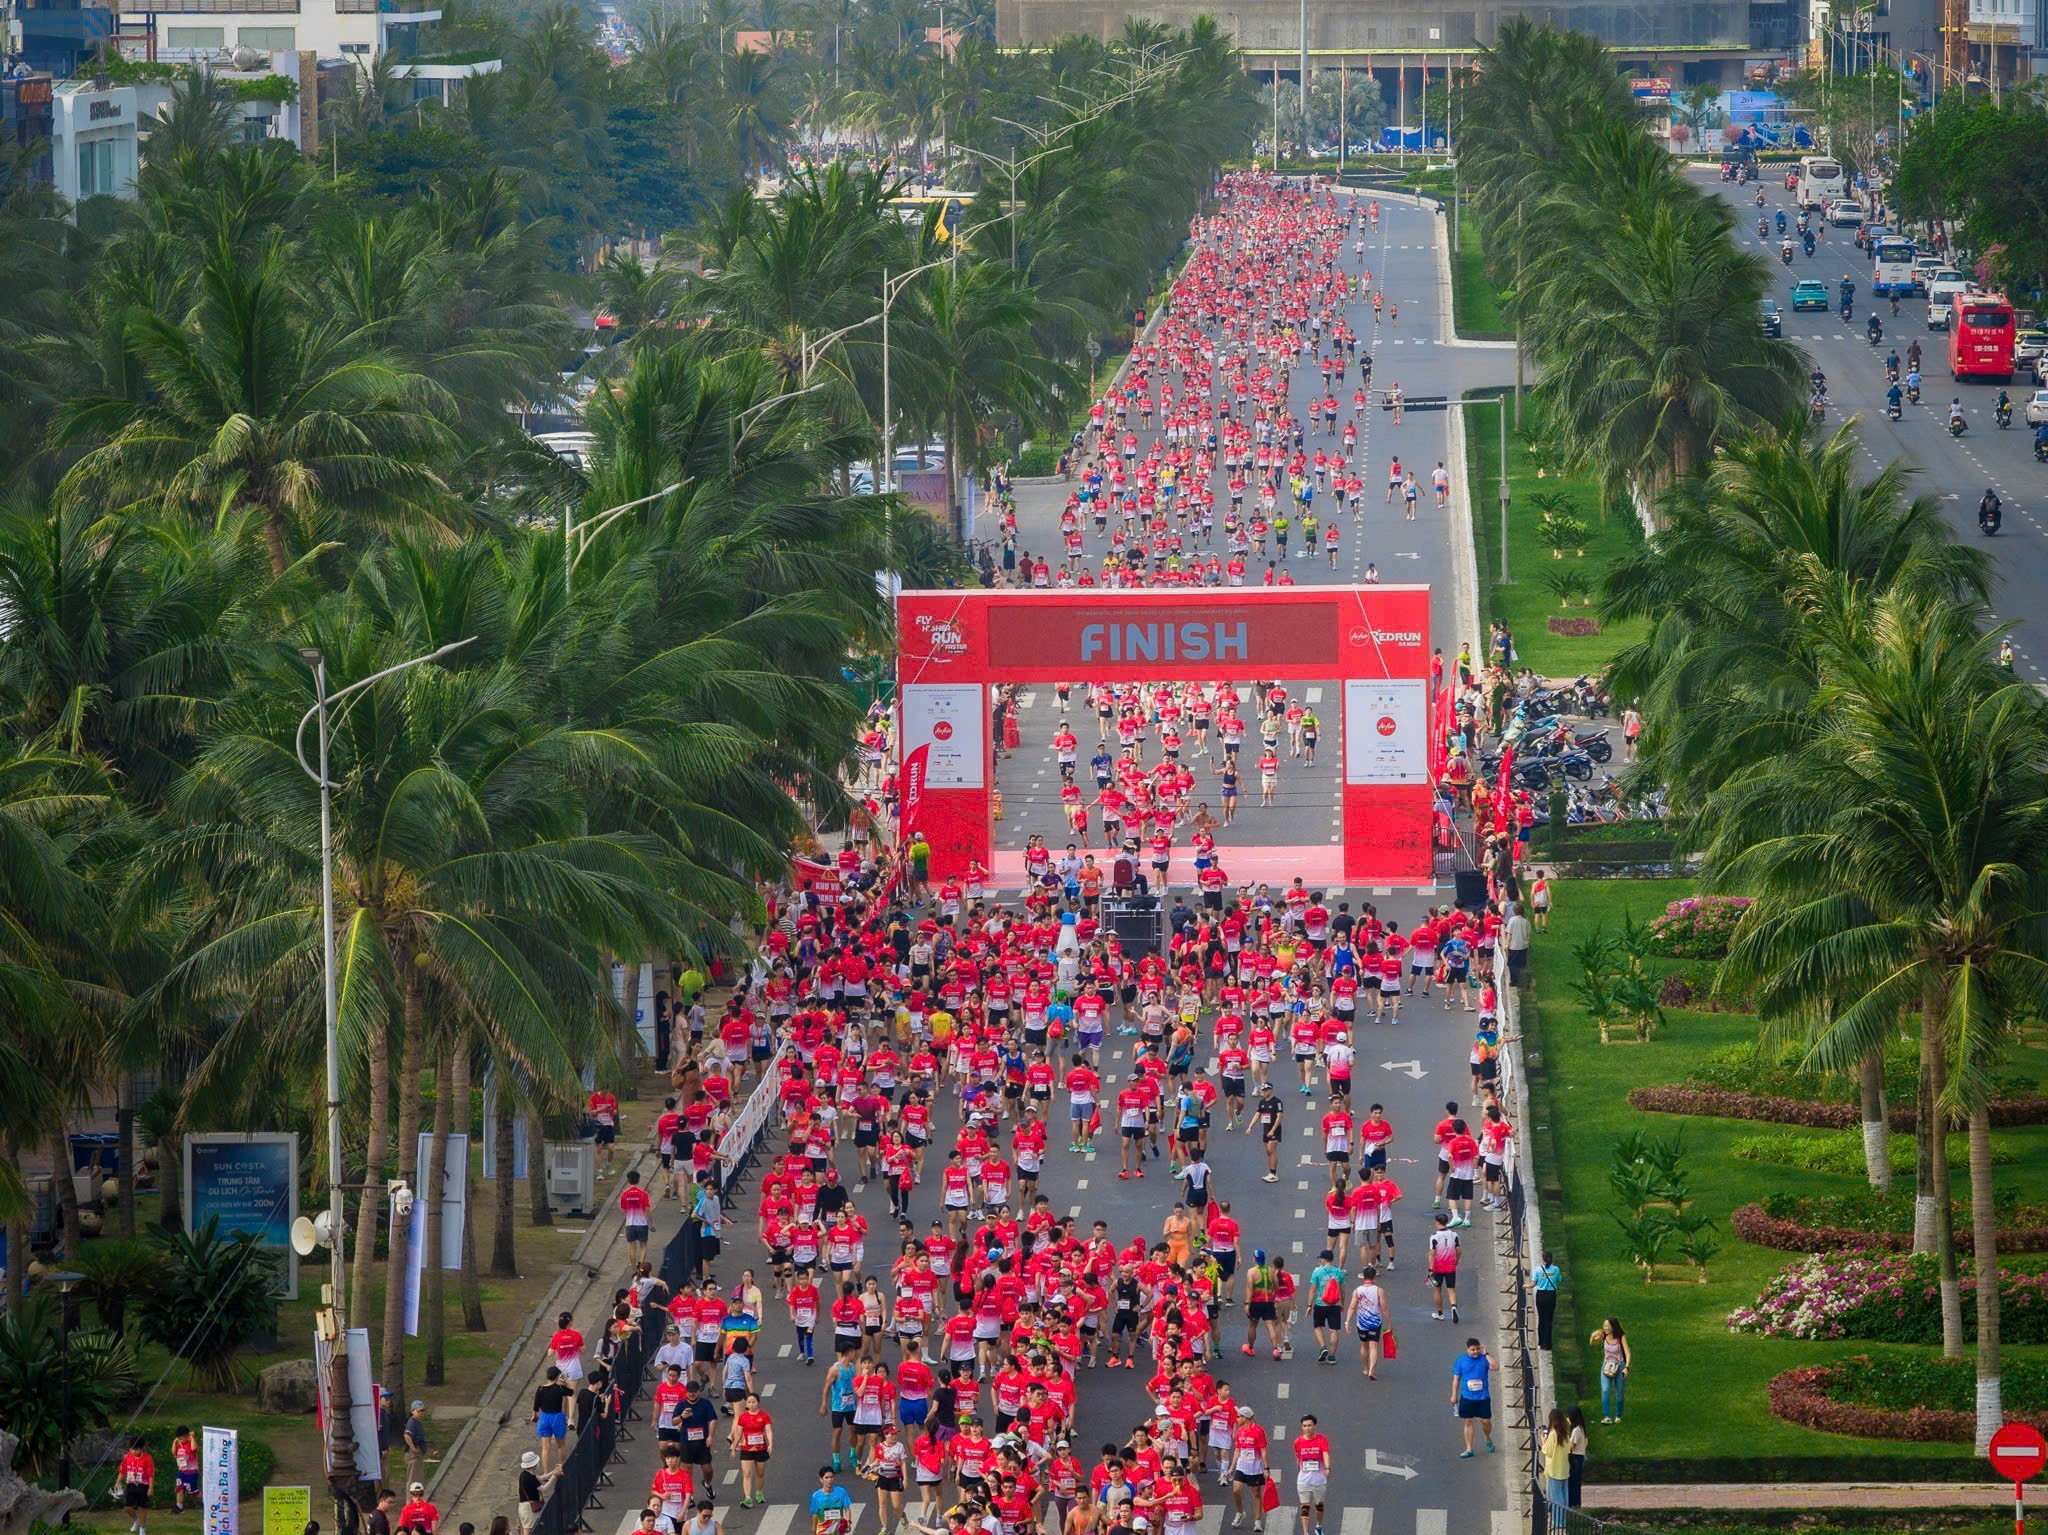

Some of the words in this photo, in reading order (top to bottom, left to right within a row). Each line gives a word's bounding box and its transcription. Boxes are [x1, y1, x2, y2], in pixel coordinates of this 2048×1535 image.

[915, 615, 933, 625] FLY
[931, 632, 961, 644] RUN
[1081, 623, 1248, 661] FINISH
[213, 1163, 232, 1171] SUN
[235, 1162, 265, 1170] COSTA
[218, 1177, 242, 1186] TRUNG
[208, 1187, 220, 1196] DU
